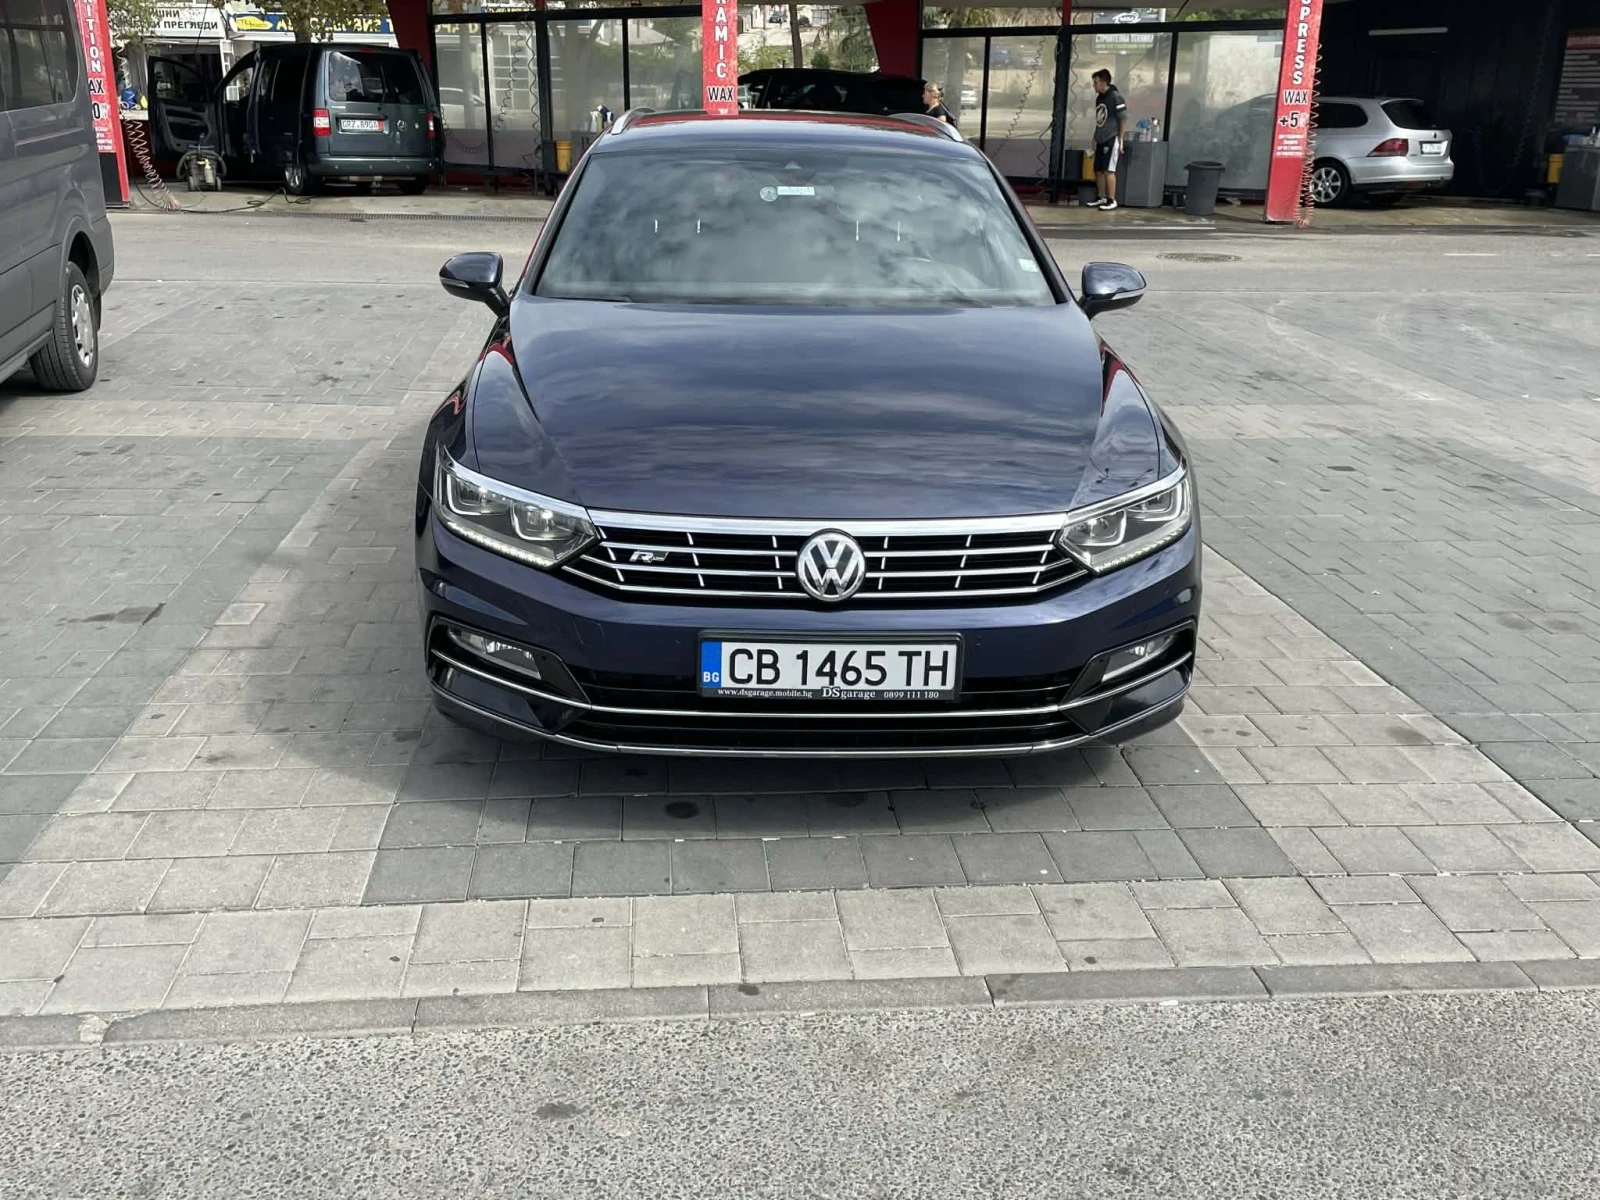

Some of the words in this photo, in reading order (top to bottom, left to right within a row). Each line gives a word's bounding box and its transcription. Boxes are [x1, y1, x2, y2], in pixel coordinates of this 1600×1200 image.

[163, 21, 218, 30] ПРЕГЛЕДИ
[88, 78, 105, 94] AX
[707, 86, 735, 102] WAX
[1284, 89, 1309, 104] WAX
[729, 648, 780, 685] CB
[796, 650, 887, 686] 1465
[898, 650, 949, 686] TH
[703, 671, 720, 683] BG
[717, 688, 813, 699] www.dsgarage.mobile.bg
[883, 690, 905, 699] 0899
[907, 691, 921, 699] 111
[924, 691, 939, 699] 180
